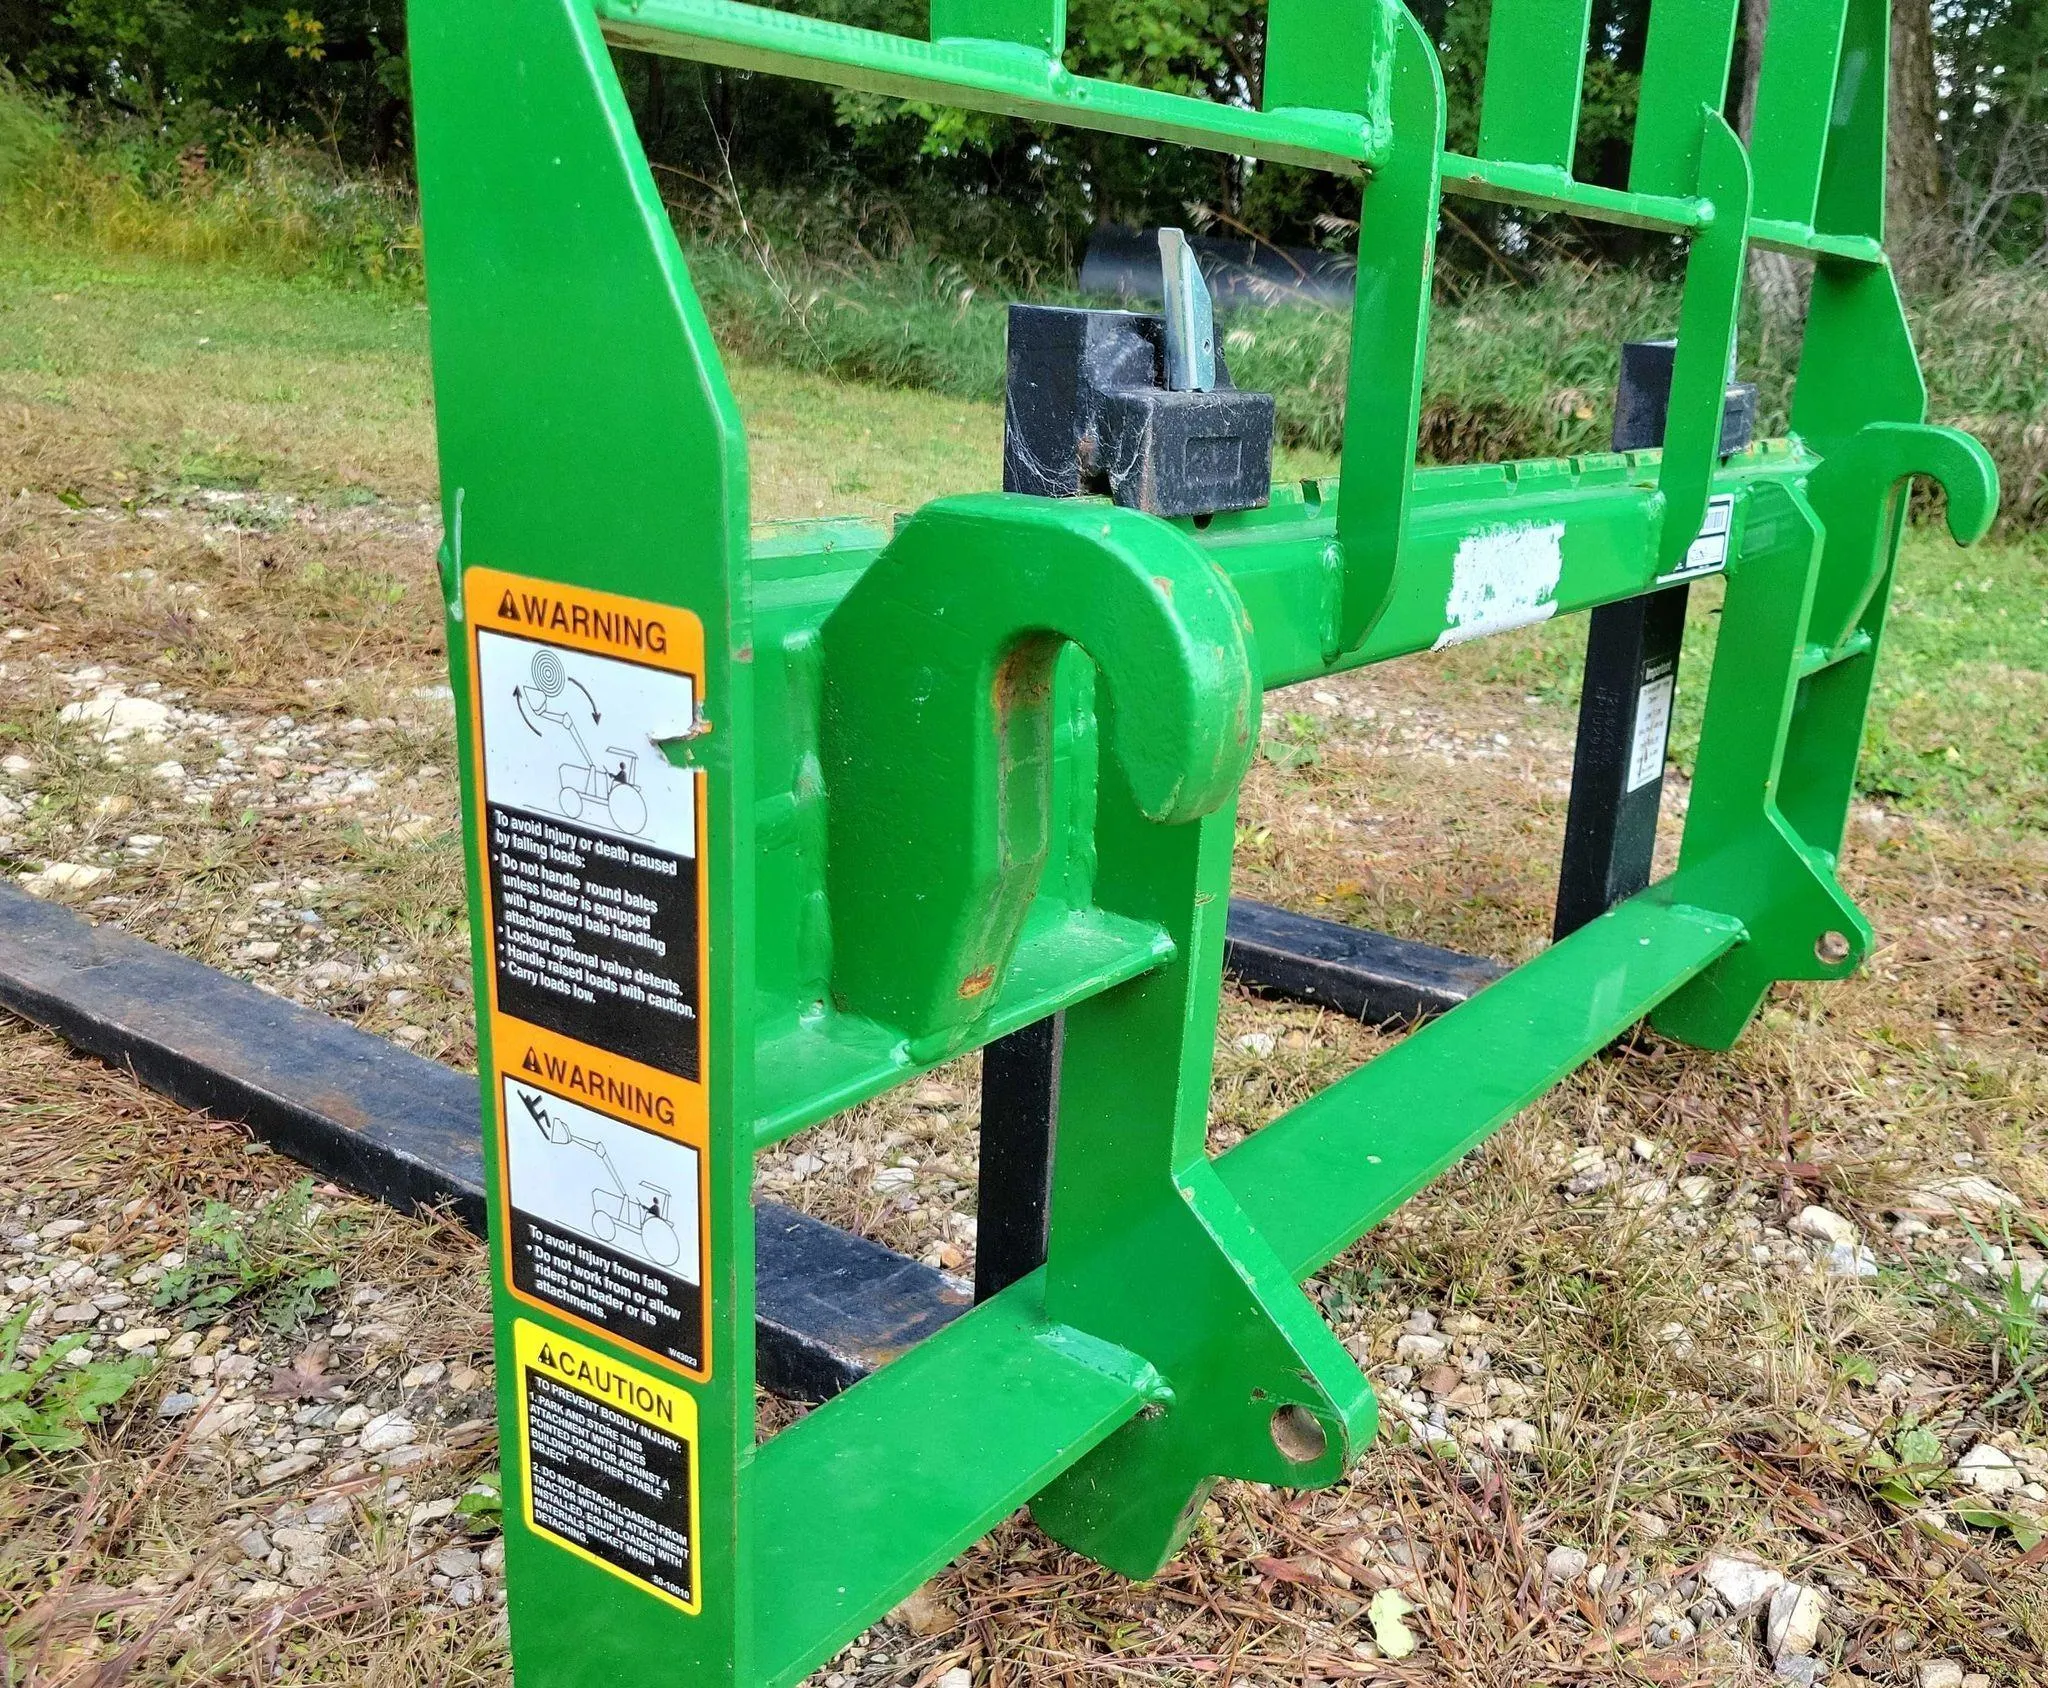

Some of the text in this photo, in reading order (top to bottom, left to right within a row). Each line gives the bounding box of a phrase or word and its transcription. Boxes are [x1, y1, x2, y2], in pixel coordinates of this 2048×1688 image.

[521, 594, 667, 654] WARNING
[495, 810, 677, 876] To avoid injury or death caused
[496, 831, 586, 868] by falling loads:
[502, 853, 658, 913] Do not handle round bales
[504, 876, 650, 930] unless loader is equipped
[504, 892, 666, 956] with approved bale handling
[505, 910, 576, 943] attachments.
[507, 925, 683, 996] Lockout optional valve detents.
[507, 943, 696, 1019] Handle raised loads with caution.
[508, 961, 596, 1003] Carry loads low.
[543, 1052, 675, 1126] WARNING
[528, 1224, 668, 1296] To avoid injury from falls
[535, 1246, 681, 1321] Do not work from or allow
[535, 1263, 656, 1325] riders on loader or its
[536, 1279, 607, 1319] attachments.
[560, 1351, 673, 1422] CAUTION
[668, 1347, 697, 1366] W43023
[529, 1392, 642, 1451] 1. PARK AND STORE THIS
[531, 1404, 646, 1466] ATTACHMENT WITH TINES
[535, 1377, 681, 1453] TO PREVENT BODILY INJURY:
[531, 1416, 670, 1490] POINTED DOWN OR AGAINST A
[531, 1428, 663, 1500] BUILDING OR OTHER STABLE
[532, 1440, 569, 1466] OBJECT.
[533, 1462, 687, 1546] 2. DO NOT DETACH LOADER FROM
[533, 1474, 689, 1559] TRACTOR WITH THIS ATTACHMENT
[534, 1486, 682, 1568] INSTALLED. EQUIP LOADER WITH
[534, 1497, 655, 1566] MATERIALS BUCKET WHEN
[535, 1509, 589, 1544] DETACHING.
